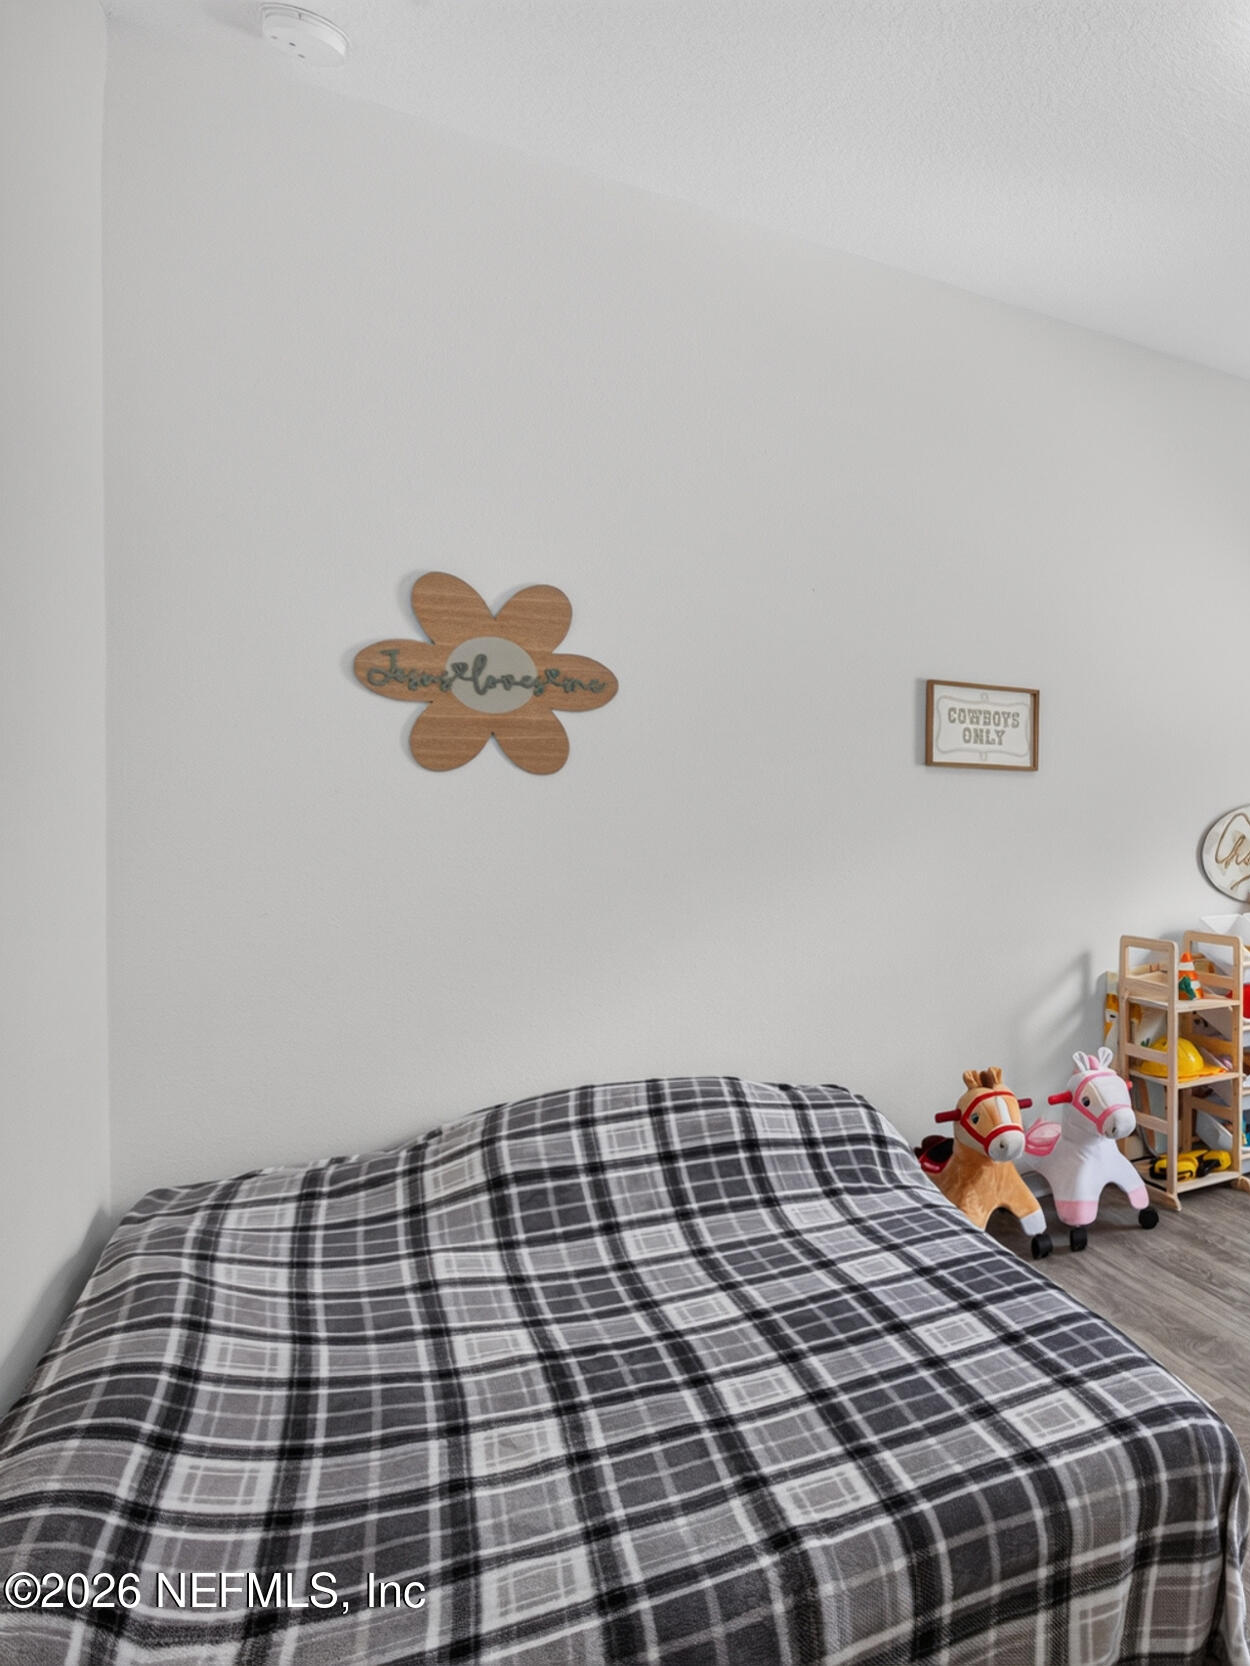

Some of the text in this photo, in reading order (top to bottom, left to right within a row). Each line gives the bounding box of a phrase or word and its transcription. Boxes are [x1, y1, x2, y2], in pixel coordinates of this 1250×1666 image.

[366, 649, 607, 696] Jesus loves me
[947, 707, 1020, 728] COWBOYS
[962, 727, 1006, 746] ONLY
